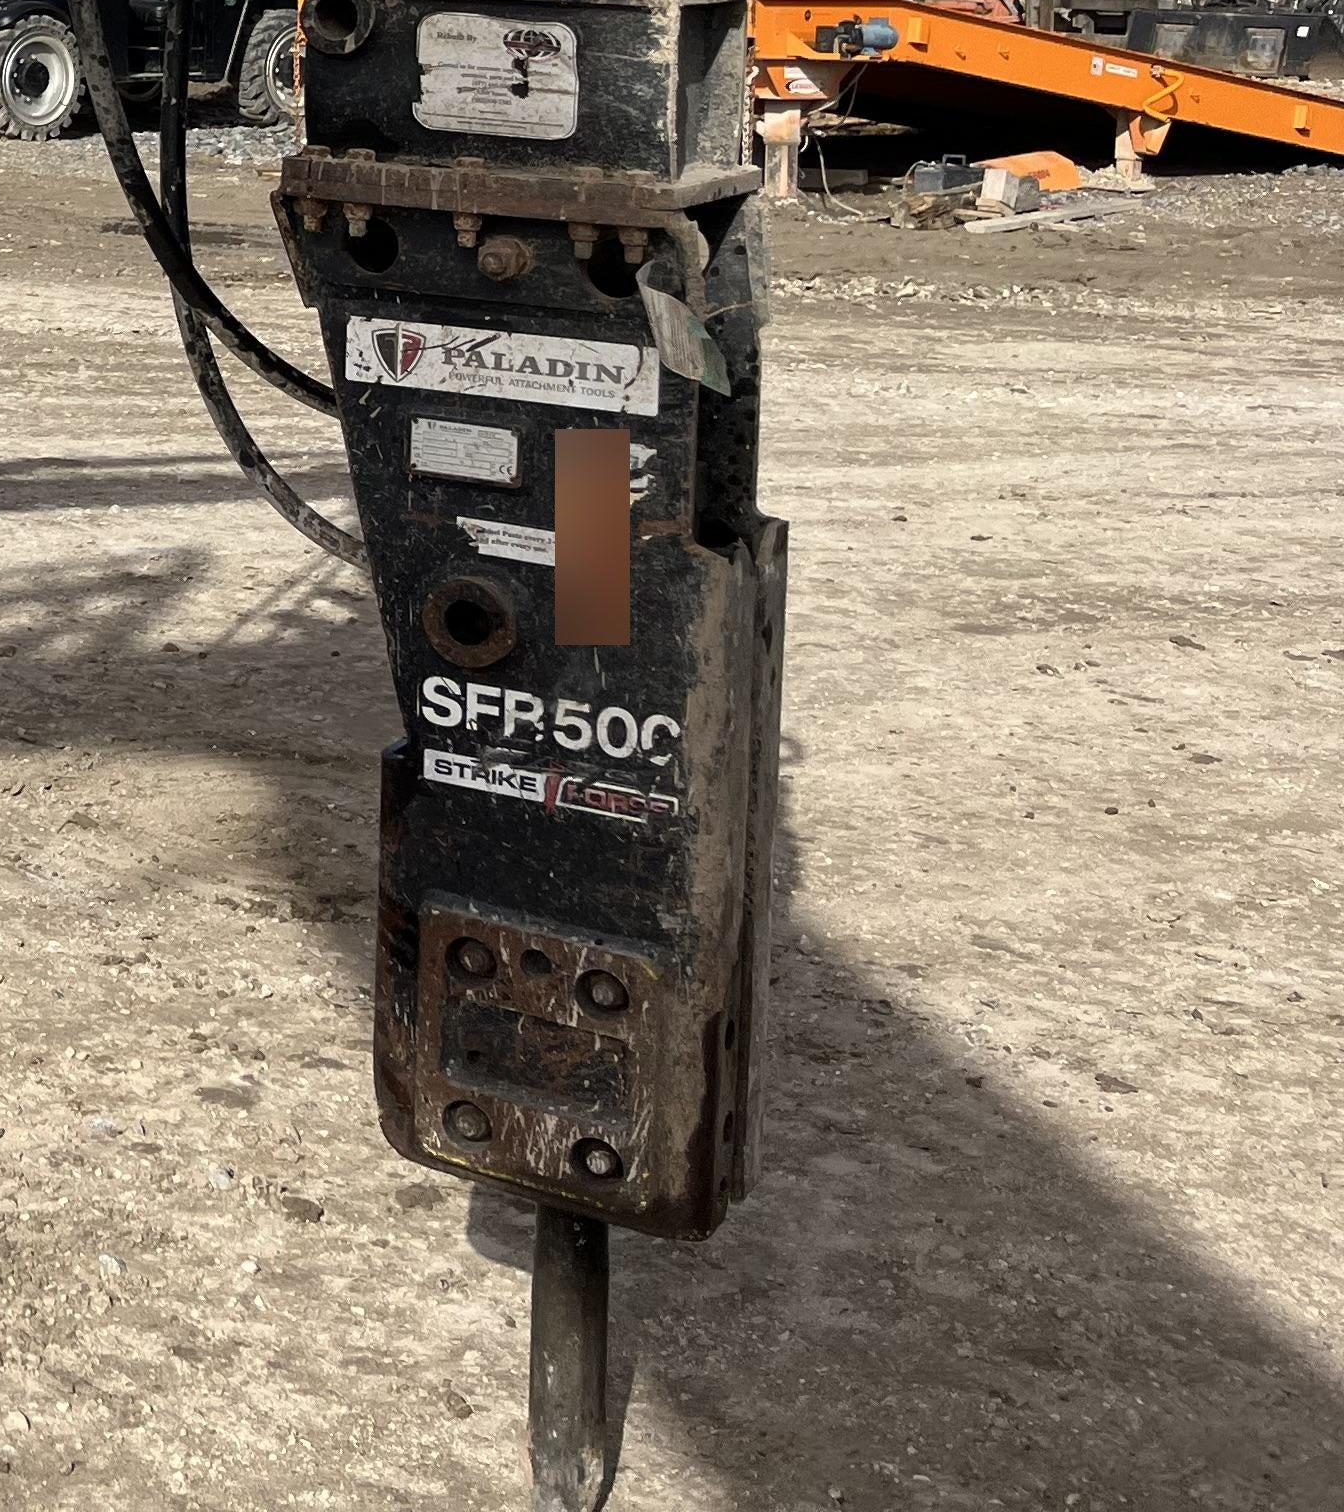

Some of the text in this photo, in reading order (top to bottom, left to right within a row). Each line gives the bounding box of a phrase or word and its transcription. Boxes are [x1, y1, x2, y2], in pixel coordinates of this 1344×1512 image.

[441, 346, 623, 386] PALADIN
[448, 372, 615, 399] POWERFUL ATTACHMENT TOOLS
[434, 759, 537, 793] STRIKE
